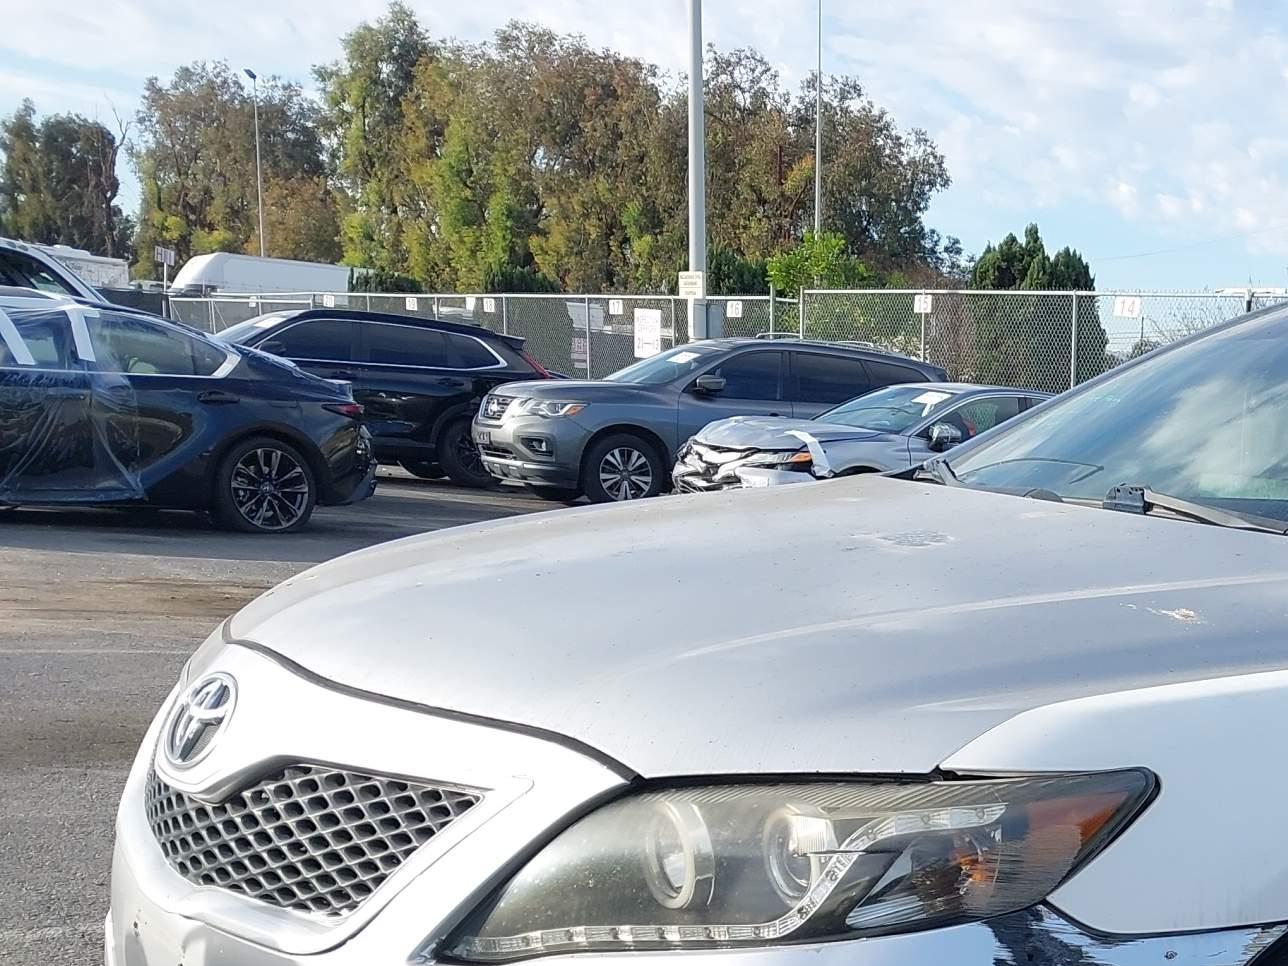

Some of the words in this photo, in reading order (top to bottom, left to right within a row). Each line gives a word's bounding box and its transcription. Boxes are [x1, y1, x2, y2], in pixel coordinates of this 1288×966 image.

[612, 300, 621, 313] 17
[729, 302, 740, 316] 16
[918, 296, 929, 311] 15
[1120, 299, 1135, 316] 14
